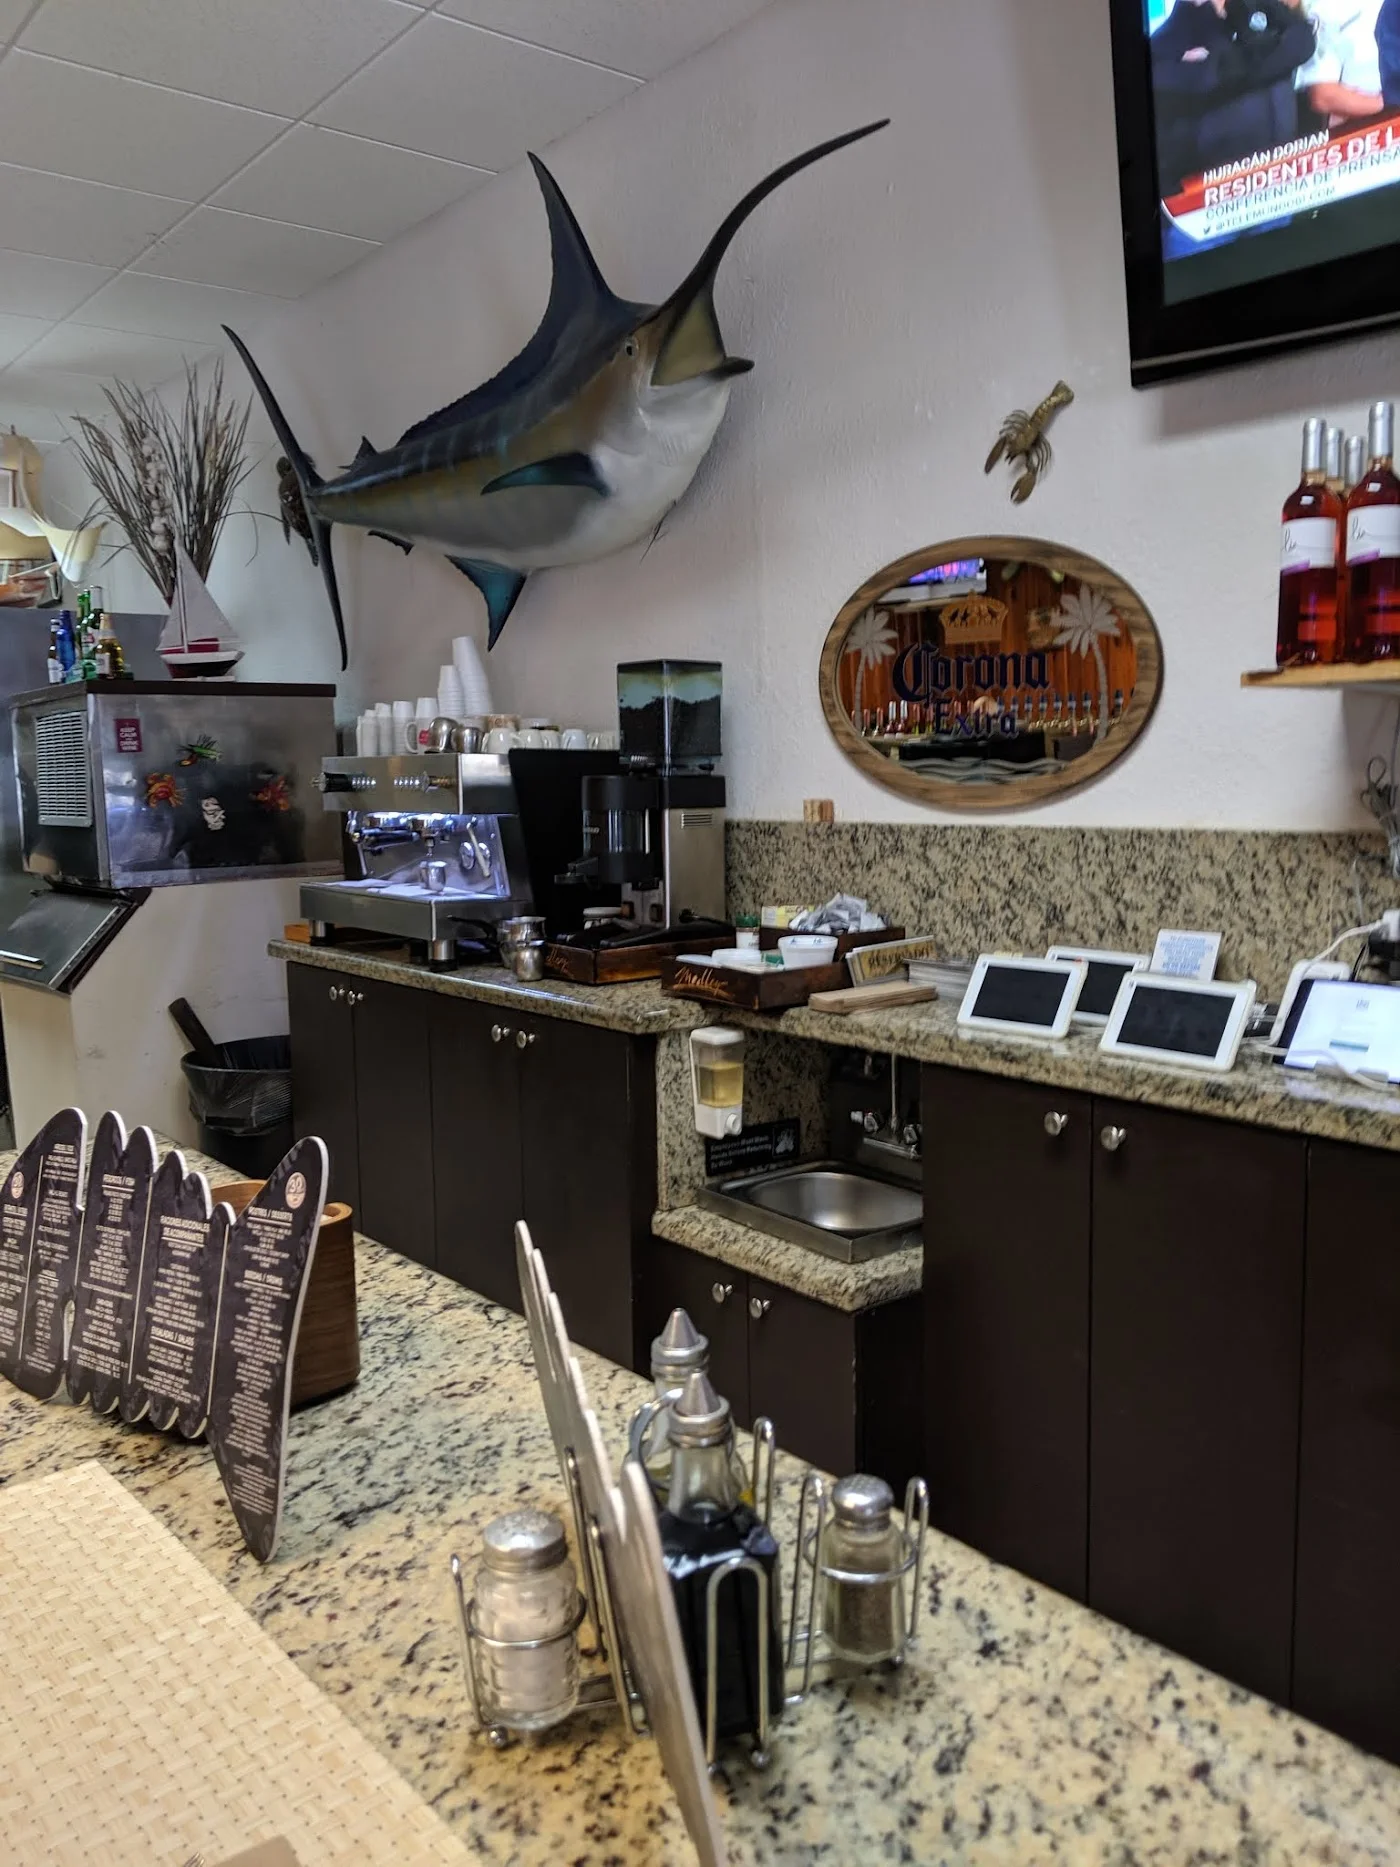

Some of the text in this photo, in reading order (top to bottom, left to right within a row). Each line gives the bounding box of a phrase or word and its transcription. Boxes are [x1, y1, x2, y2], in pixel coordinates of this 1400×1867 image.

[1203, 144, 1343, 208] RESIDENTES
[1347, 130, 1381, 162] DE
[1271, 128, 1330, 159] DORIAN
[1206, 178, 1309, 220] CONFERENCIA
[1312, 168, 1333, 184] DE
[892, 641, 1050, 708] Corona
[935, 697, 1019, 739] Extra
